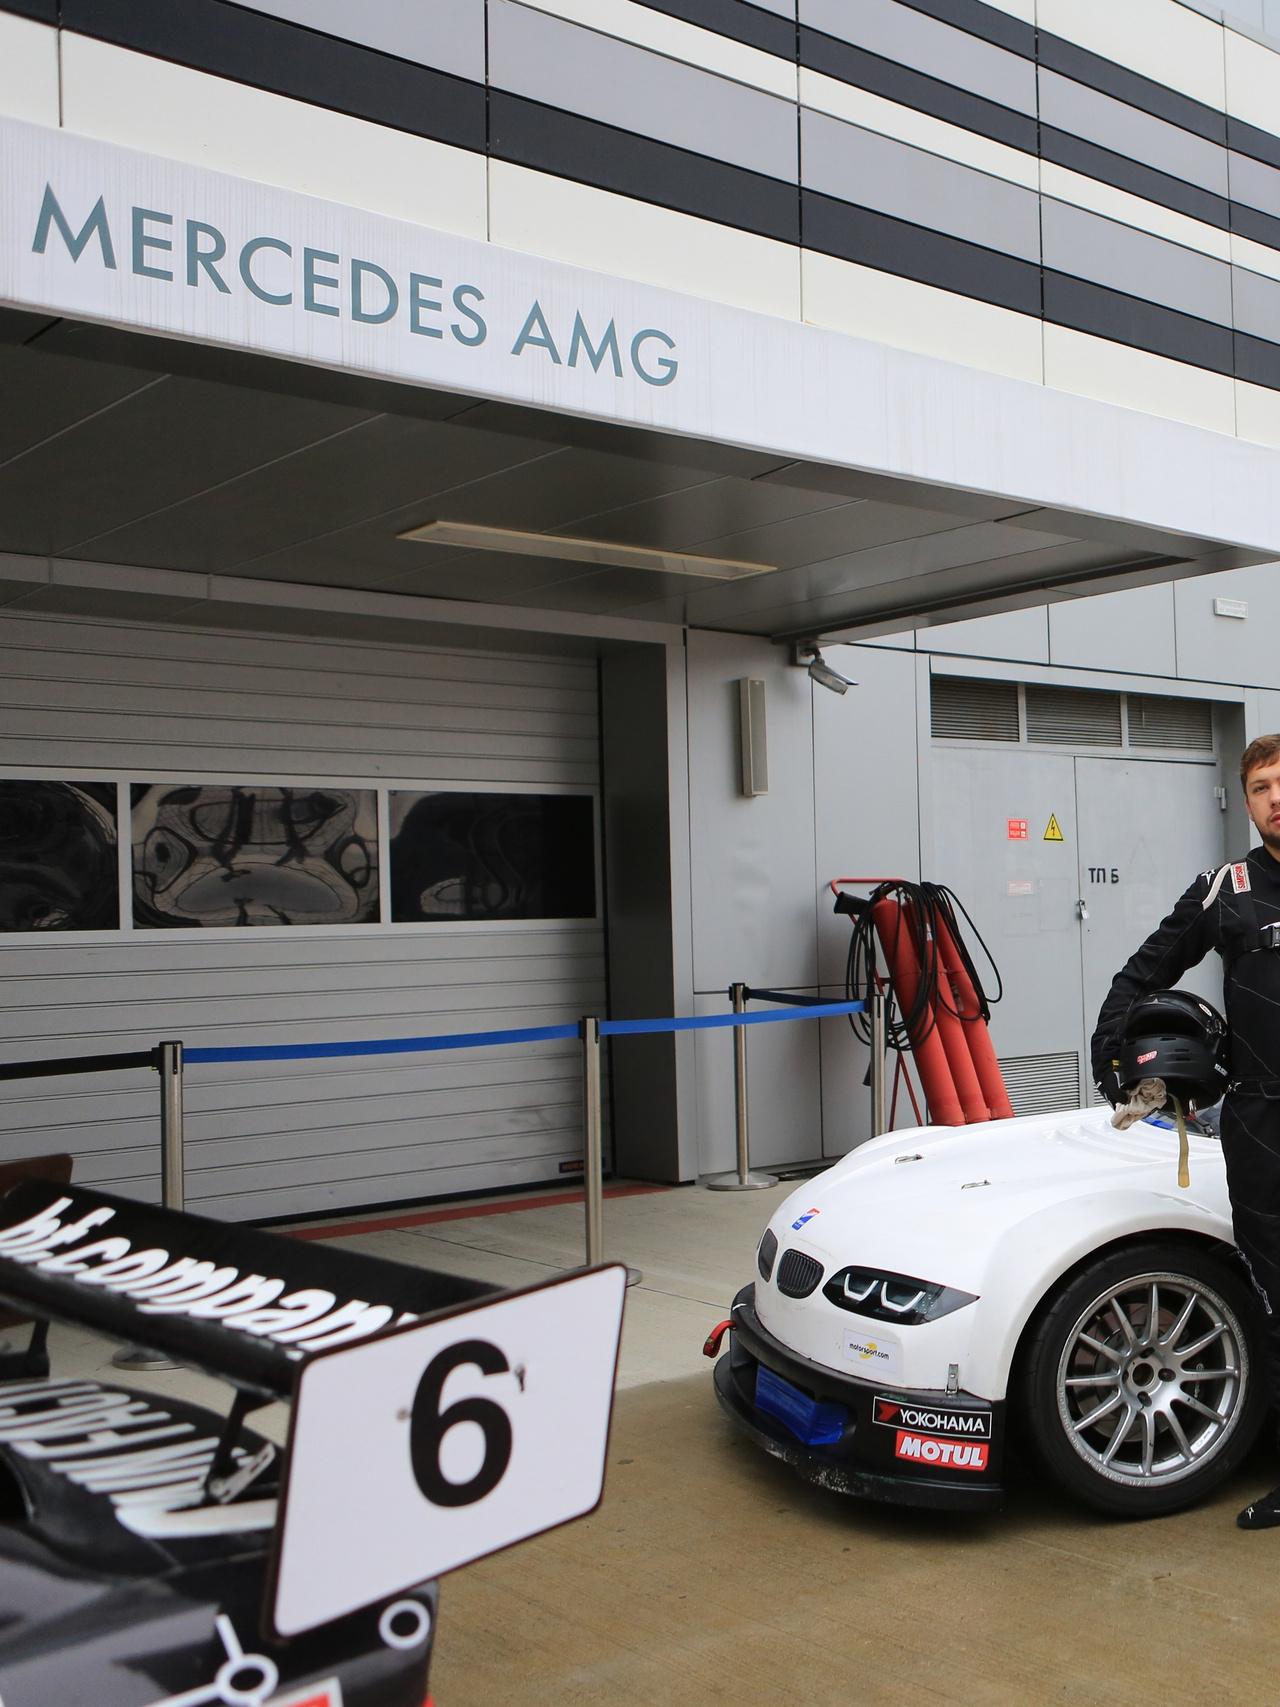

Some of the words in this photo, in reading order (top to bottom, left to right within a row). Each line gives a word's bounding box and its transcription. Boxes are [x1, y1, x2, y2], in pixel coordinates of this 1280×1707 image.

[31, 181, 488, 347] MERCEDES
[511, 300, 679, 386] AMG
[1088, 867, 1106, 884] ТП
[1235, 865, 1247, 890] SIMPSON
[849, 1342, 890, 1360] motorsport.com
[408, 1338, 513, 1508] 6
[900, 1408, 985, 1433] YOKOHAMA
[899, 1435, 984, 1467] MOTUL
